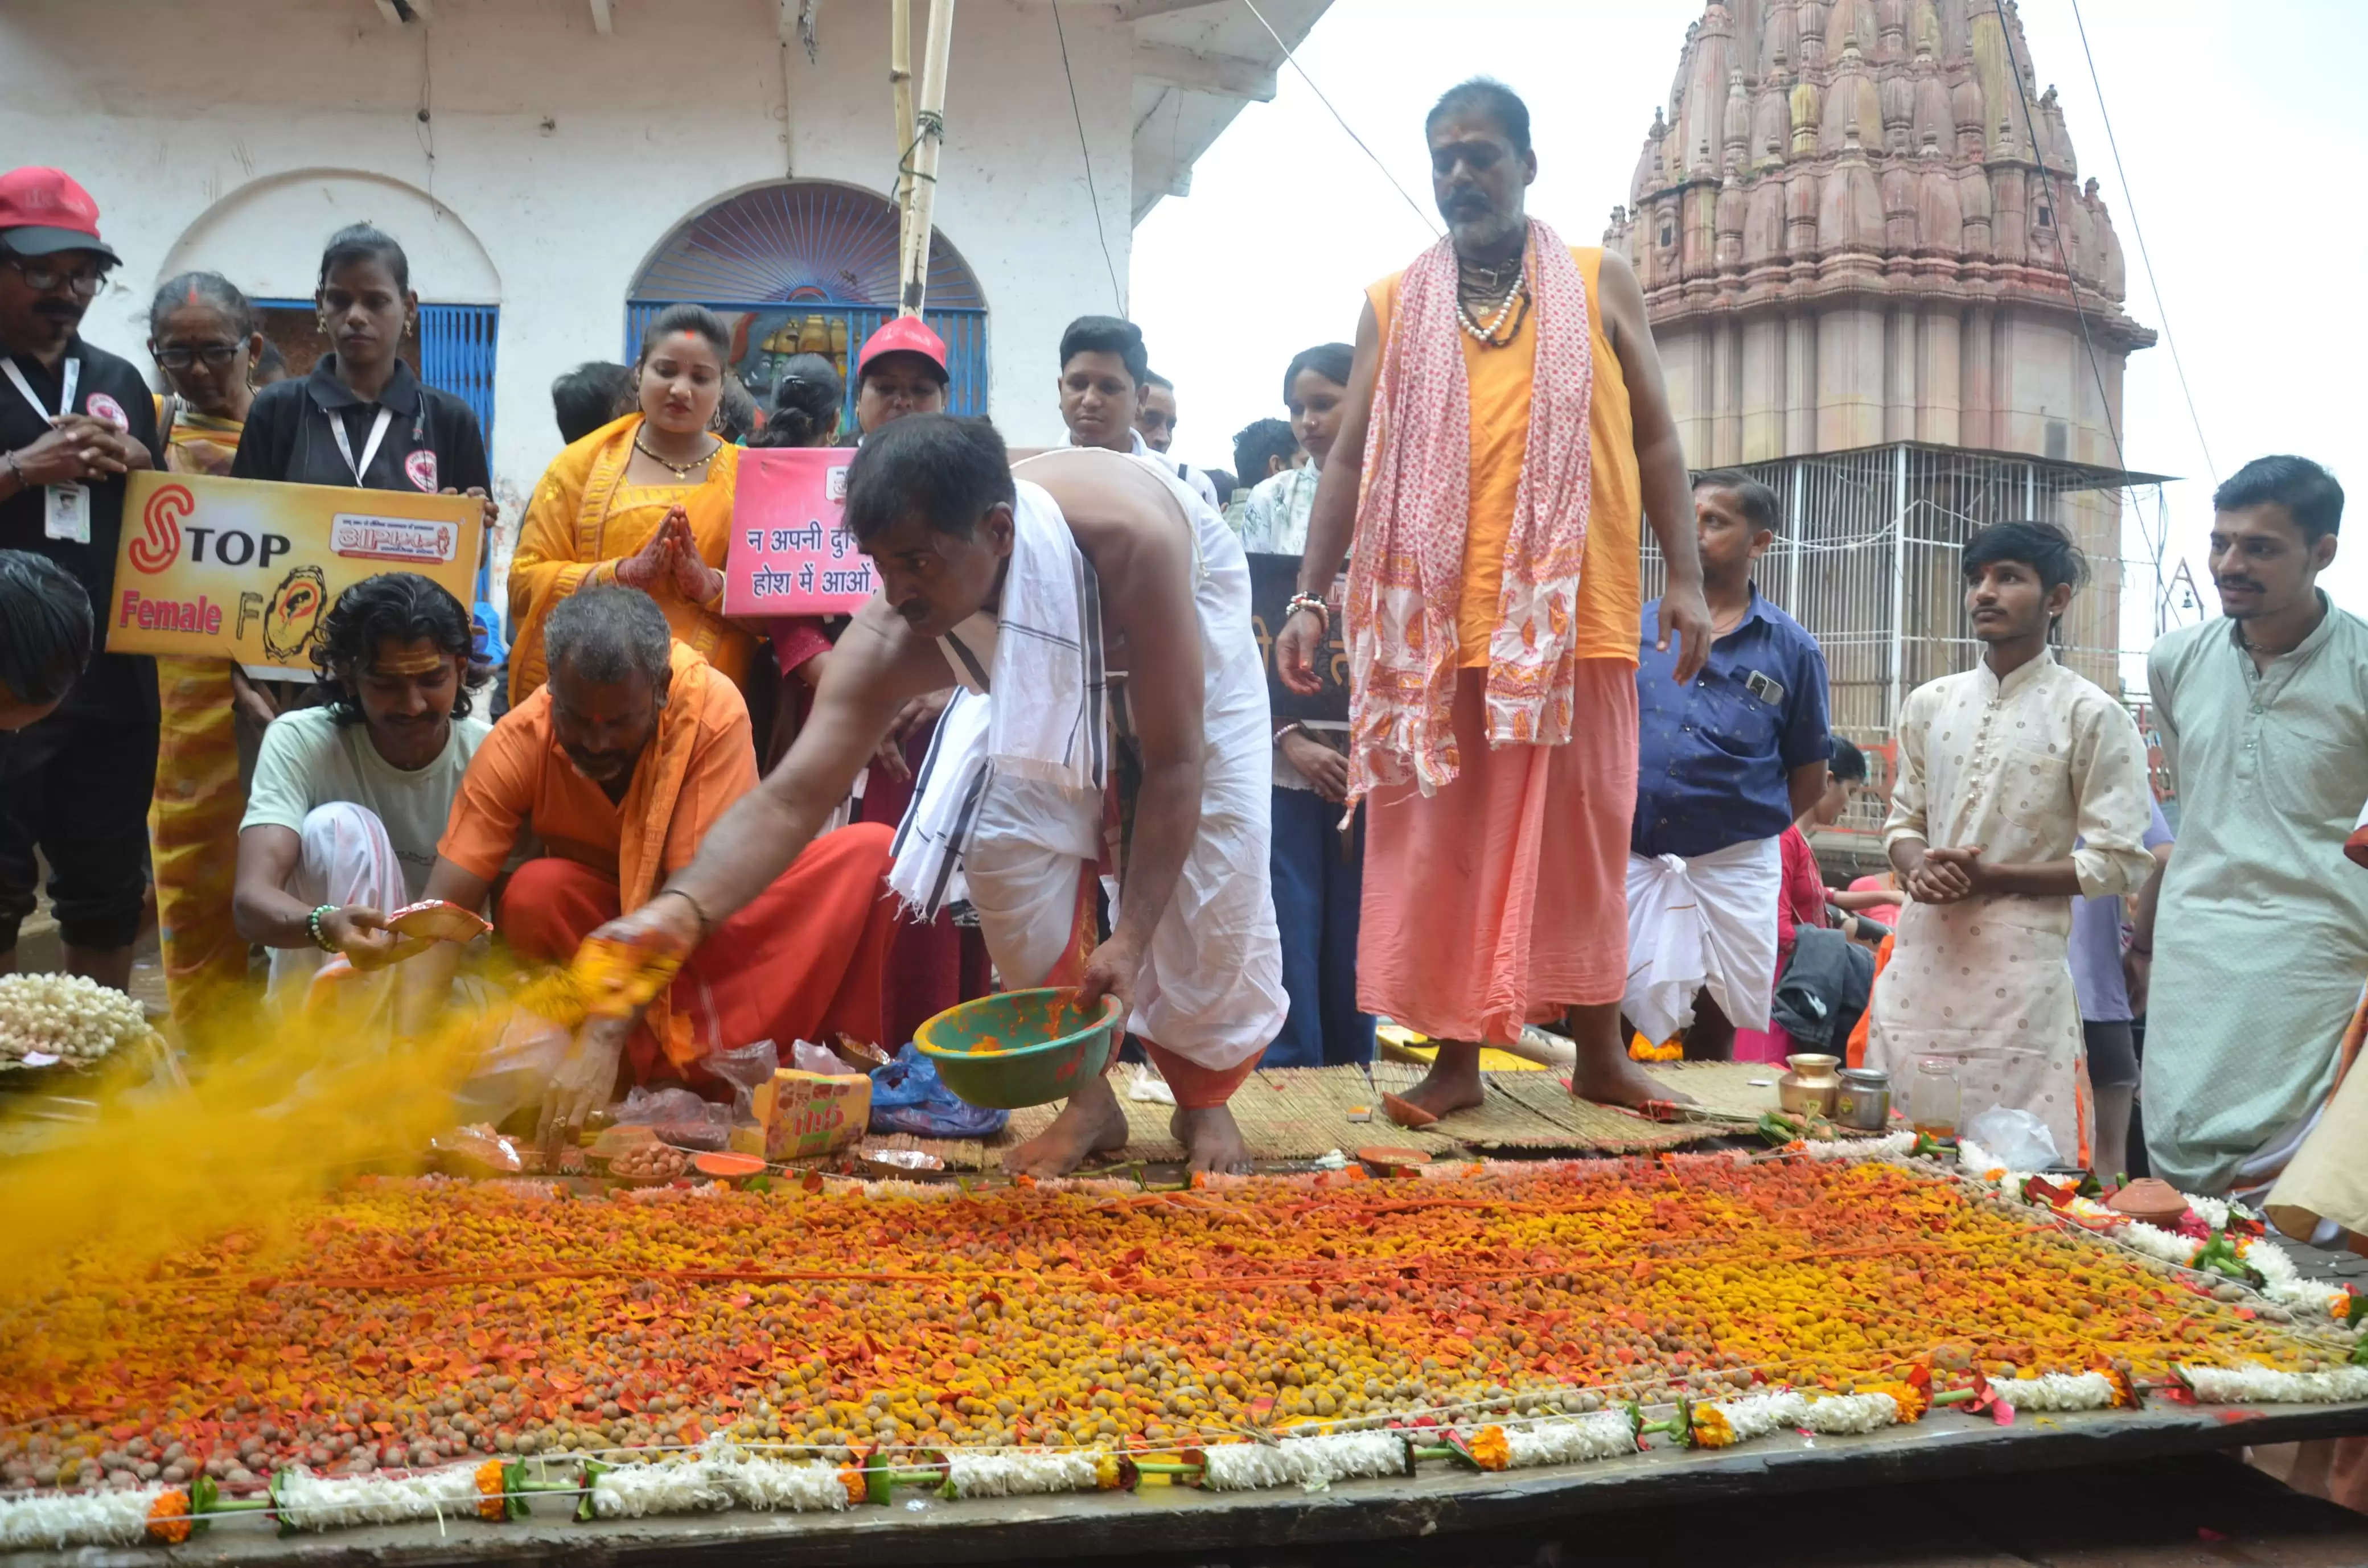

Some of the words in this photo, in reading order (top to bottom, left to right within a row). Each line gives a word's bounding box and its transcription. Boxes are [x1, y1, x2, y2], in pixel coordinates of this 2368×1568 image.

[129, 483, 291, 574] STOP
[747, 530, 764, 551] न
[771, 521, 823, 550] अपनी
[753, 563, 792, 596] होश
[799, 562, 814, 593] में
[120, 589, 222, 635] Female
